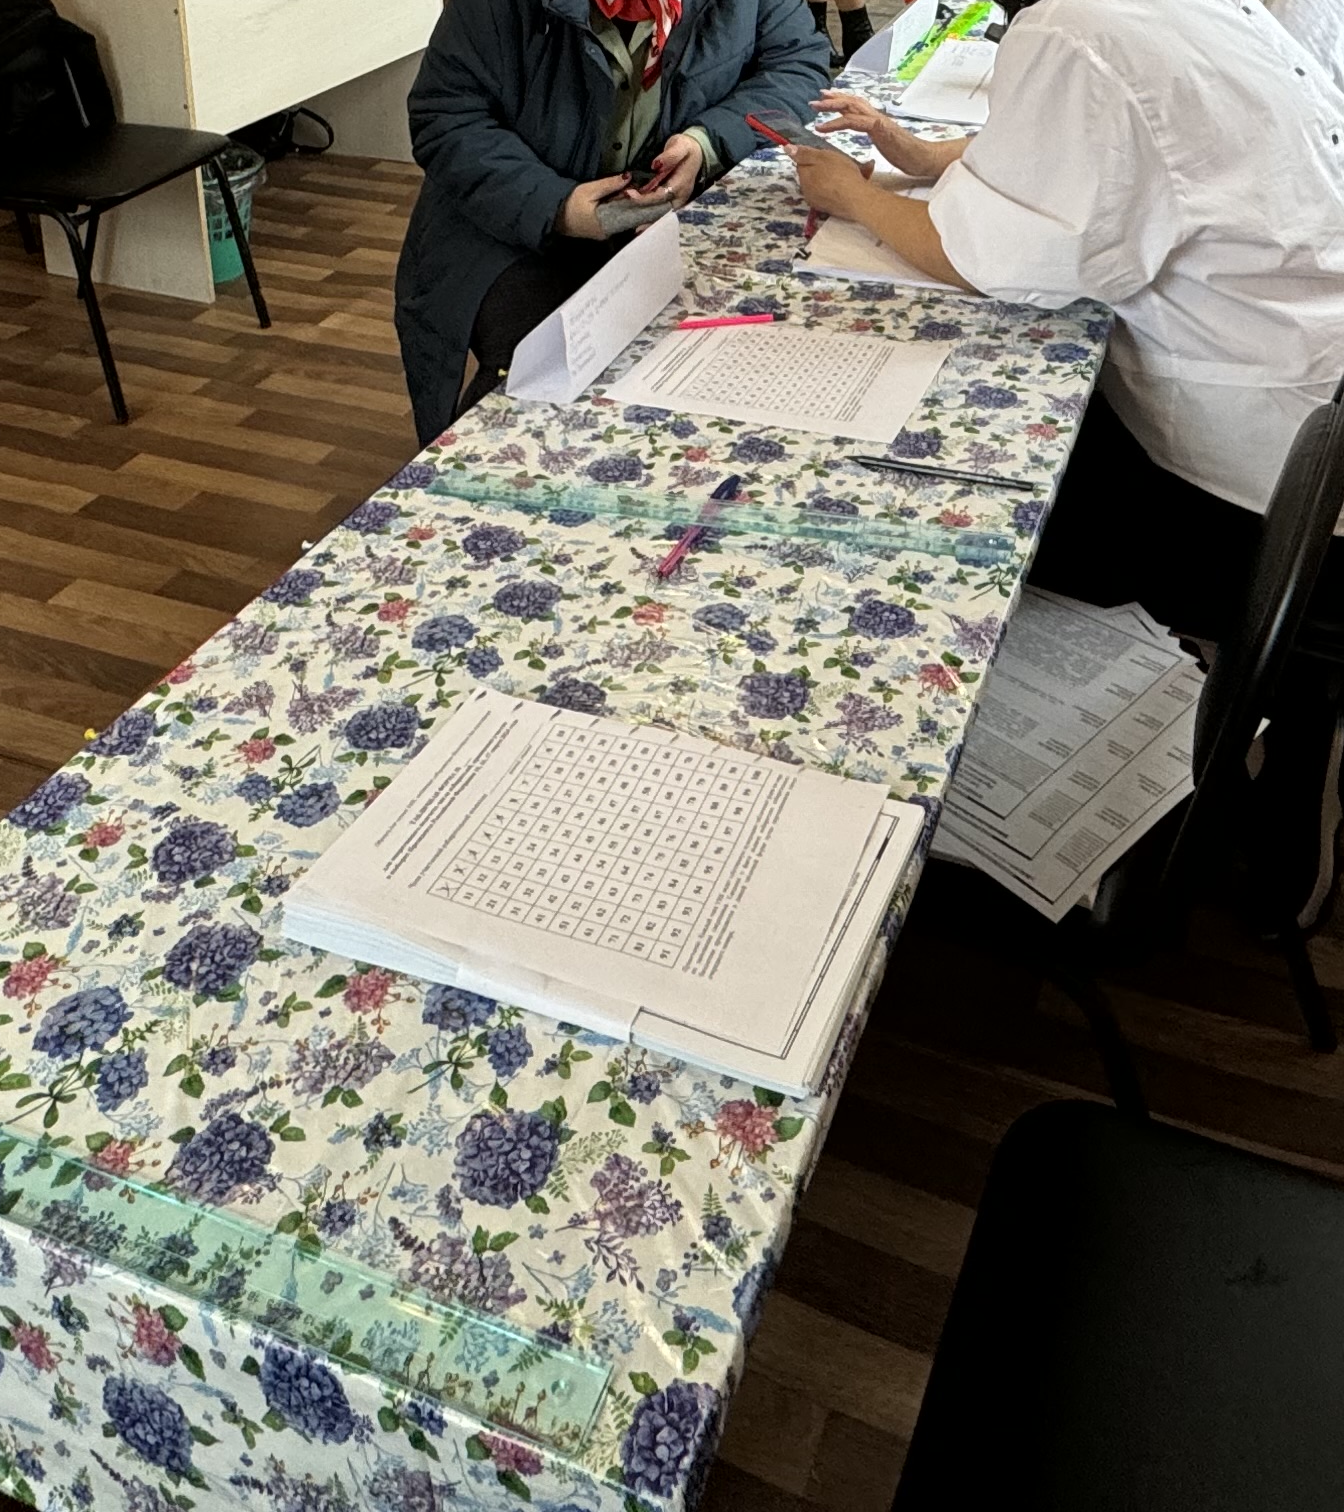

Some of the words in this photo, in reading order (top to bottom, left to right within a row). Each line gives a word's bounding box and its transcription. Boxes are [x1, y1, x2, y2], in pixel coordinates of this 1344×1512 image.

[462, 891, 473, 900] 11
[476, 873, 487, 882] 12
[490, 855, 501, 864] 13
[517, 818, 527, 827] 15
[485, 899, 497, 909] 21
[499, 880, 510, 890] 22
[512, 861, 523, 871] 23
[509, 906, 521, 915] 31
[522, 887, 534, 897] 32
[535, 914, 545, 922] 41
[547, 894, 557, 903] 42
[558, 920, 569, 929] 51
[570, 901, 582, 910] 52
[583, 880, 594, 889] 53
[596, 859, 606, 868] 54
[595, 907, 606, 917] 62
[608, 887, 617, 896] 63
[607, 934, 619, 942] 71
[619, 914, 631, 923] 72
[631, 893, 642, 902] 73
[659, 949, 670, 958] 91
[670, 927, 681, 937] 92
[681, 906, 692, 915] 93
